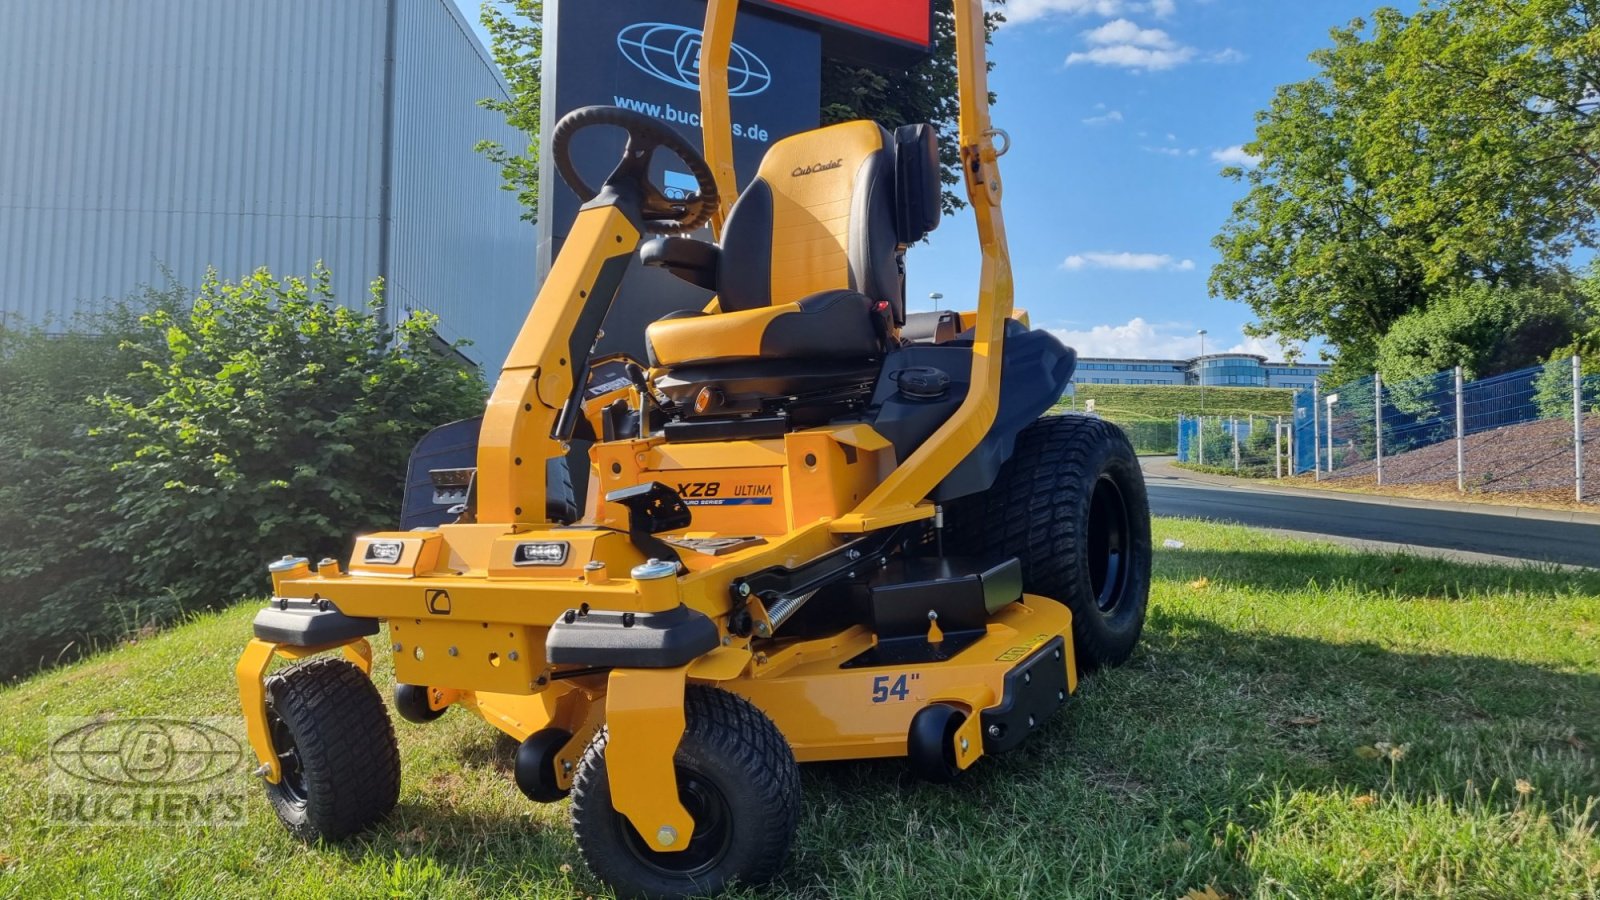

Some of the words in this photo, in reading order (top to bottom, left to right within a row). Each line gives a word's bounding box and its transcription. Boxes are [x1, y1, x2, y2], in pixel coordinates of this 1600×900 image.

[614, 95, 768, 141] www.bucs.de
[791, 166, 811, 177] Cub
[812, 158, 843, 173] Cadet
[677, 482, 720, 497] XZ8
[734, 484, 772, 496] ULTIMA
[872, 673, 920, 703] 54"
